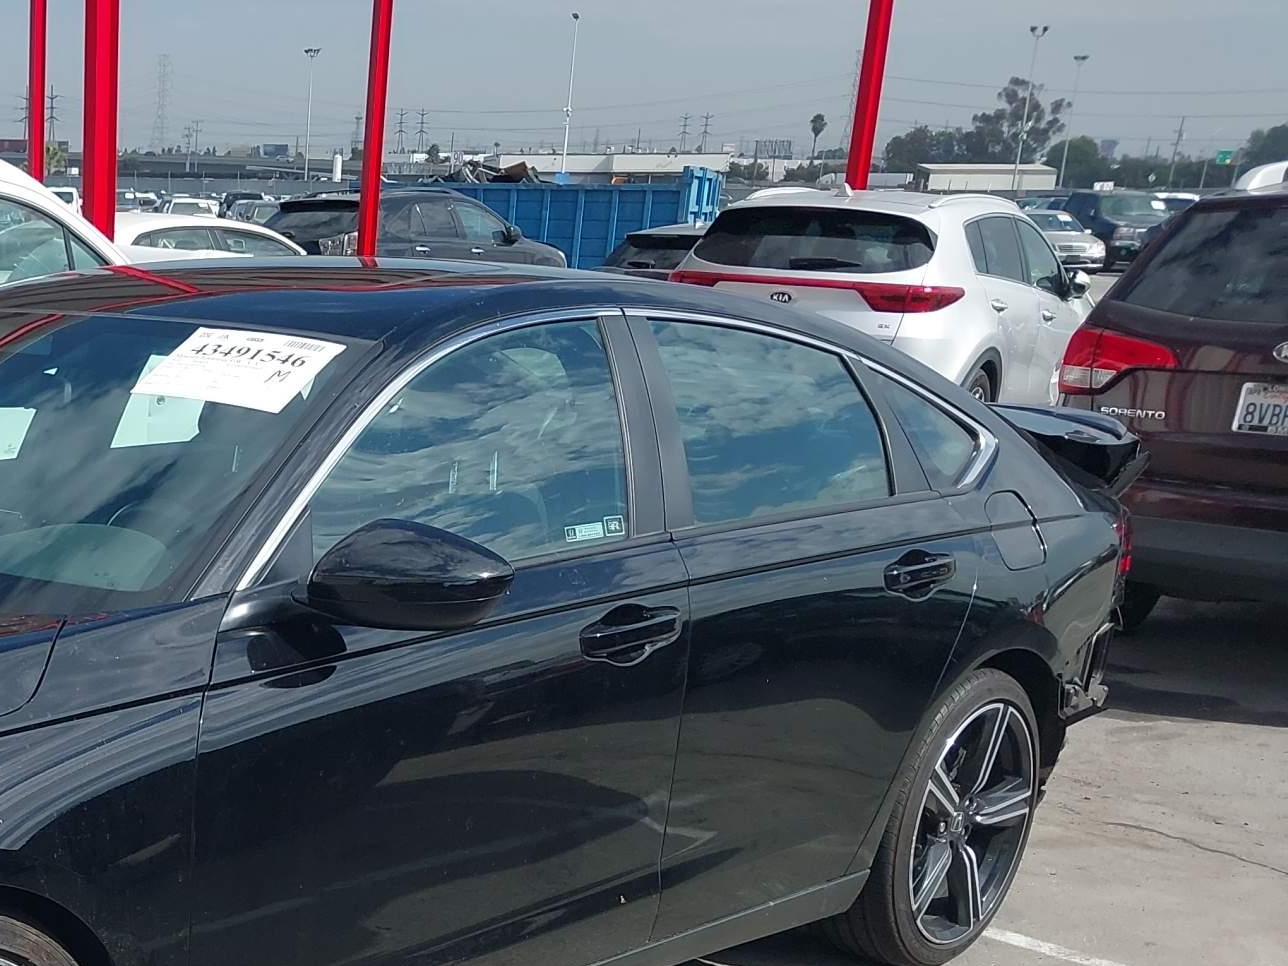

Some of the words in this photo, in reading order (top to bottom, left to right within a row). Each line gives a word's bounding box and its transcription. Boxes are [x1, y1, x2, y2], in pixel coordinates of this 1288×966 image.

[772, 292, 789, 303] KIA
[191, 343, 309, 368] 43491546
[1100, 406, 1166, 420] SORENTO
